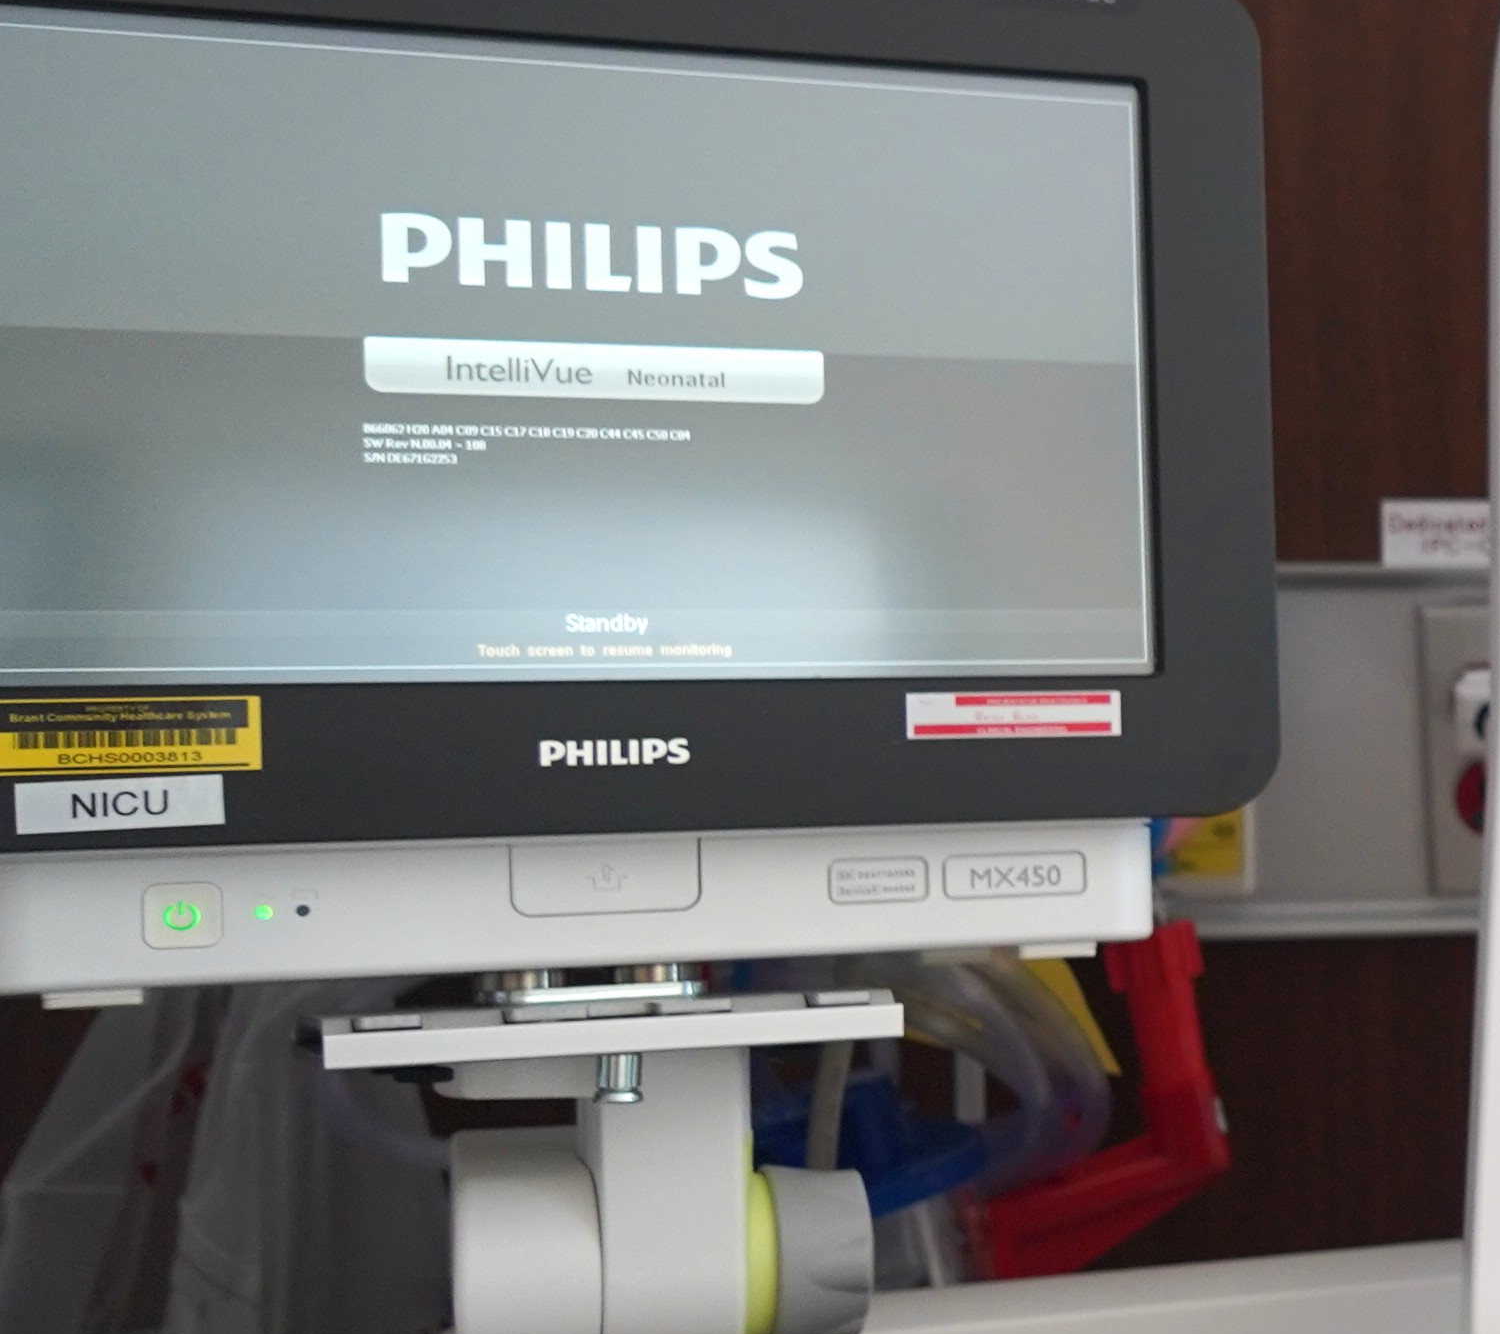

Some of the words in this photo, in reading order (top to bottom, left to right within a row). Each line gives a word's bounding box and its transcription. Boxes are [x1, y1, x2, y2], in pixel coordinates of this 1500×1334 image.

[380, 212, 804, 300] PHILIPS
[445, 355, 593, 386] IntelliVue
[627, 367, 726, 390] Neonatal
[362, 436, 385, 449] SW
[386, 437, 409, 449] Rev
[565, 613, 649, 636] Standby
[477, 643, 520, 658] Touch
[528, 645, 573, 658] screen
[579, 644, 596, 658] to
[602, 645, 653, 657] resume
[660, 642, 733, 659] monitoring
[57, 750, 203, 765] BCHS0003813
[539, 736, 691, 767] PHILIPS
[71, 788, 169, 819] NICU
[969, 863, 1062, 890] MX450
